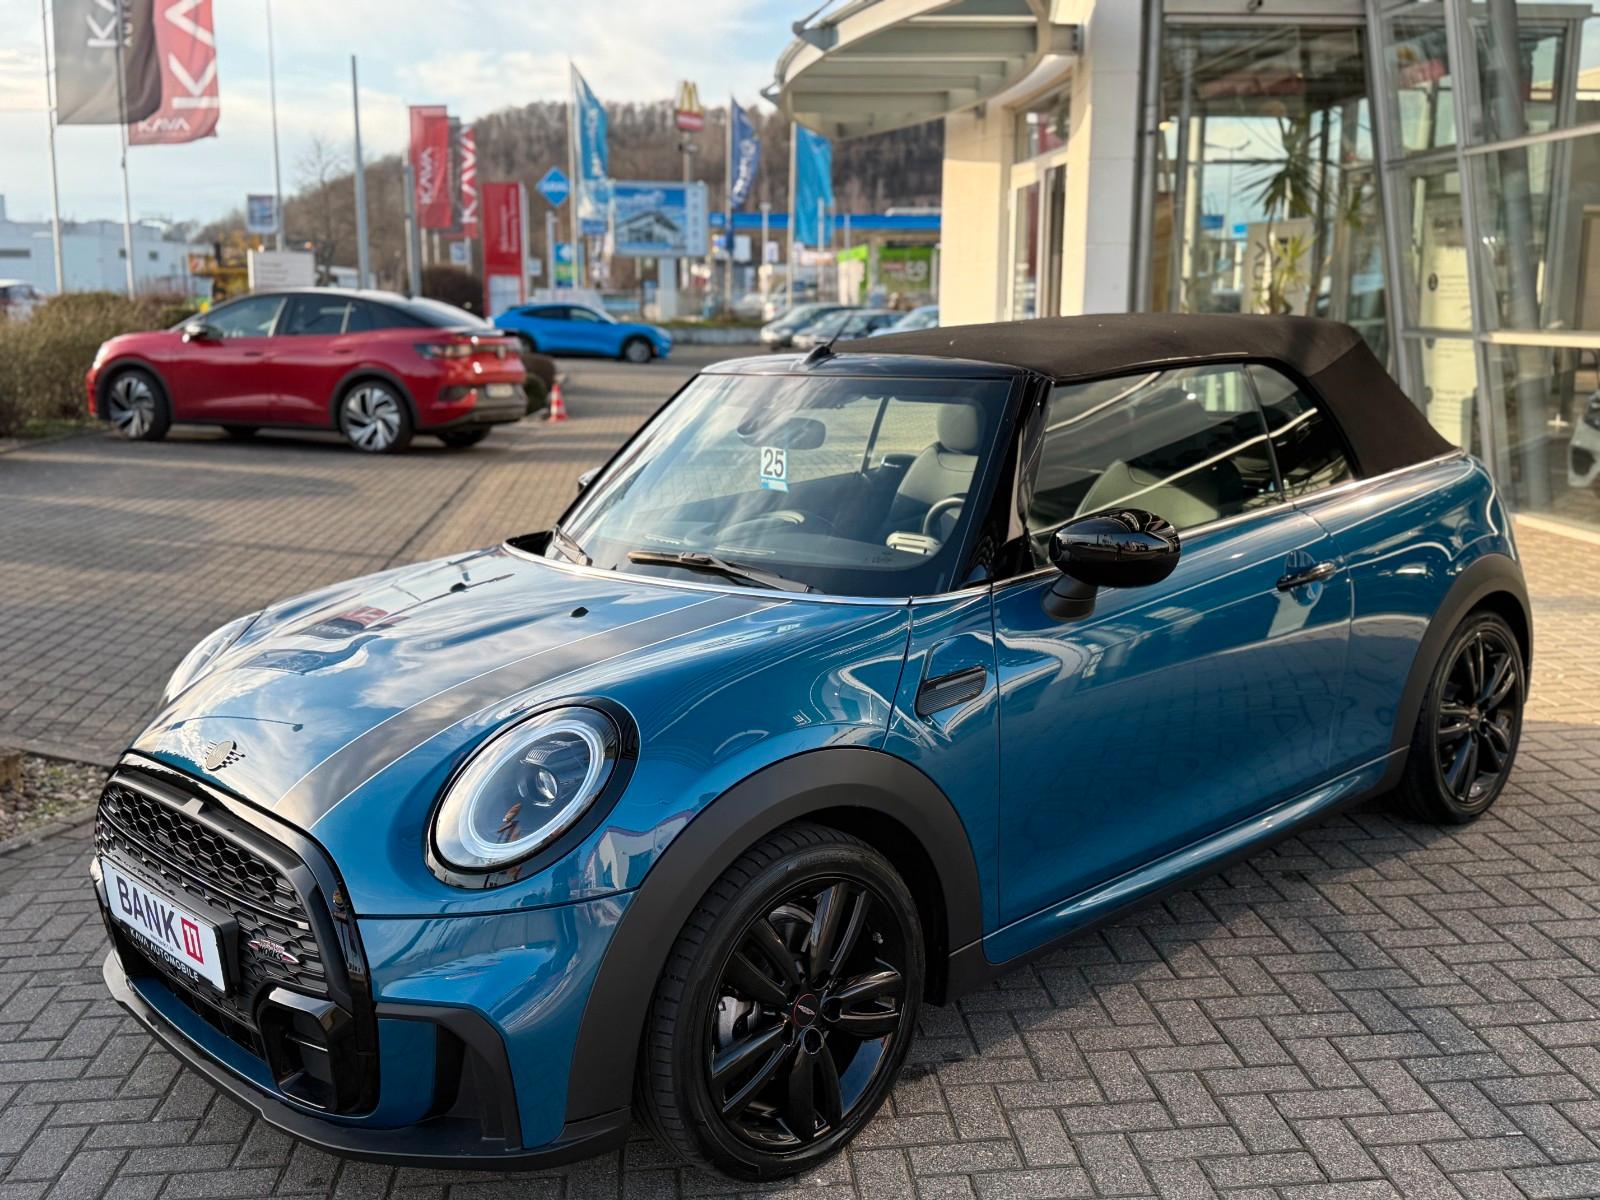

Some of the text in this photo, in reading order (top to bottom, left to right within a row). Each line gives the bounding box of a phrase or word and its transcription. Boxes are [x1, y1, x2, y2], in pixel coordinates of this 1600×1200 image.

[137, 117, 191, 133] KAVA
[420, 146, 433, 204] KAVA
[459, 123, 477, 224] KAVA
[763, 449, 784, 477] 25
[116, 875, 182, 951] BANK
[150, 943, 200, 982] AUTOMOBILE
